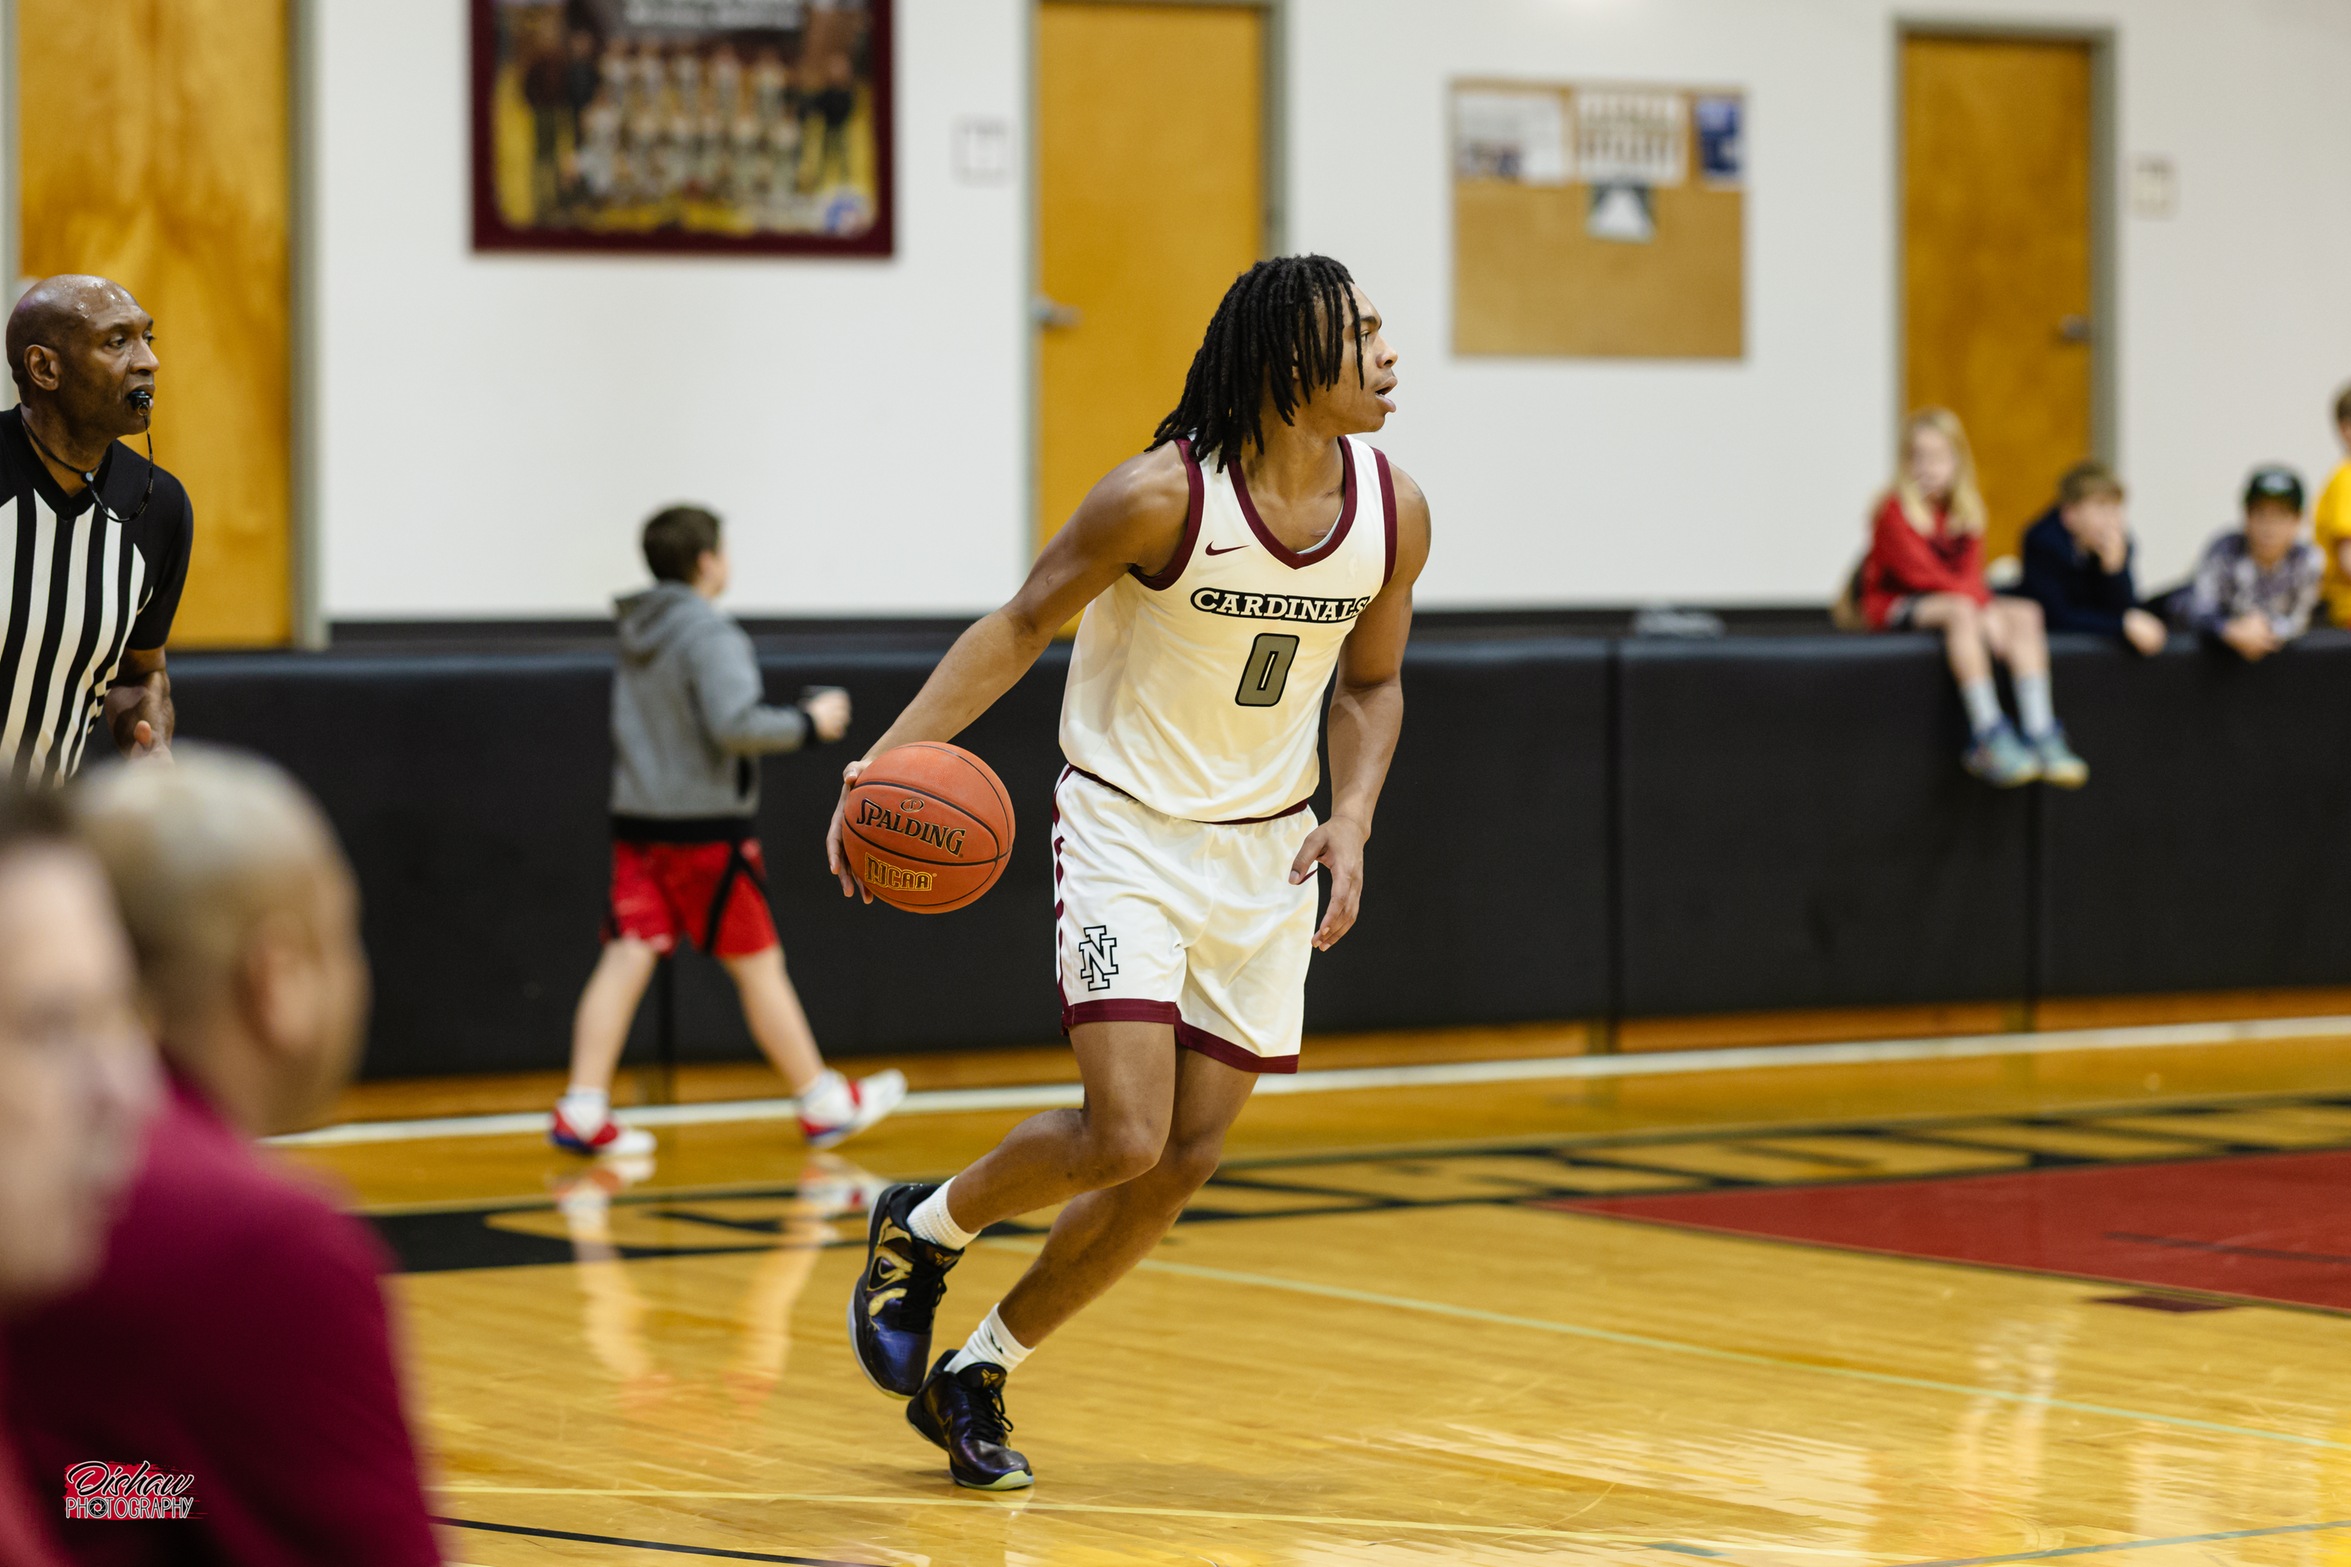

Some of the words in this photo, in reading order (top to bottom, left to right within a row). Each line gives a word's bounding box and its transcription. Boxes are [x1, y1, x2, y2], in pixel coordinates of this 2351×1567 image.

[1190, 587, 1370, 623] CARDINALS
[1235, 632, 1300, 707] 0
[857, 798, 965, 855] SPALDING
[865, 852, 932, 891] NJCAA
